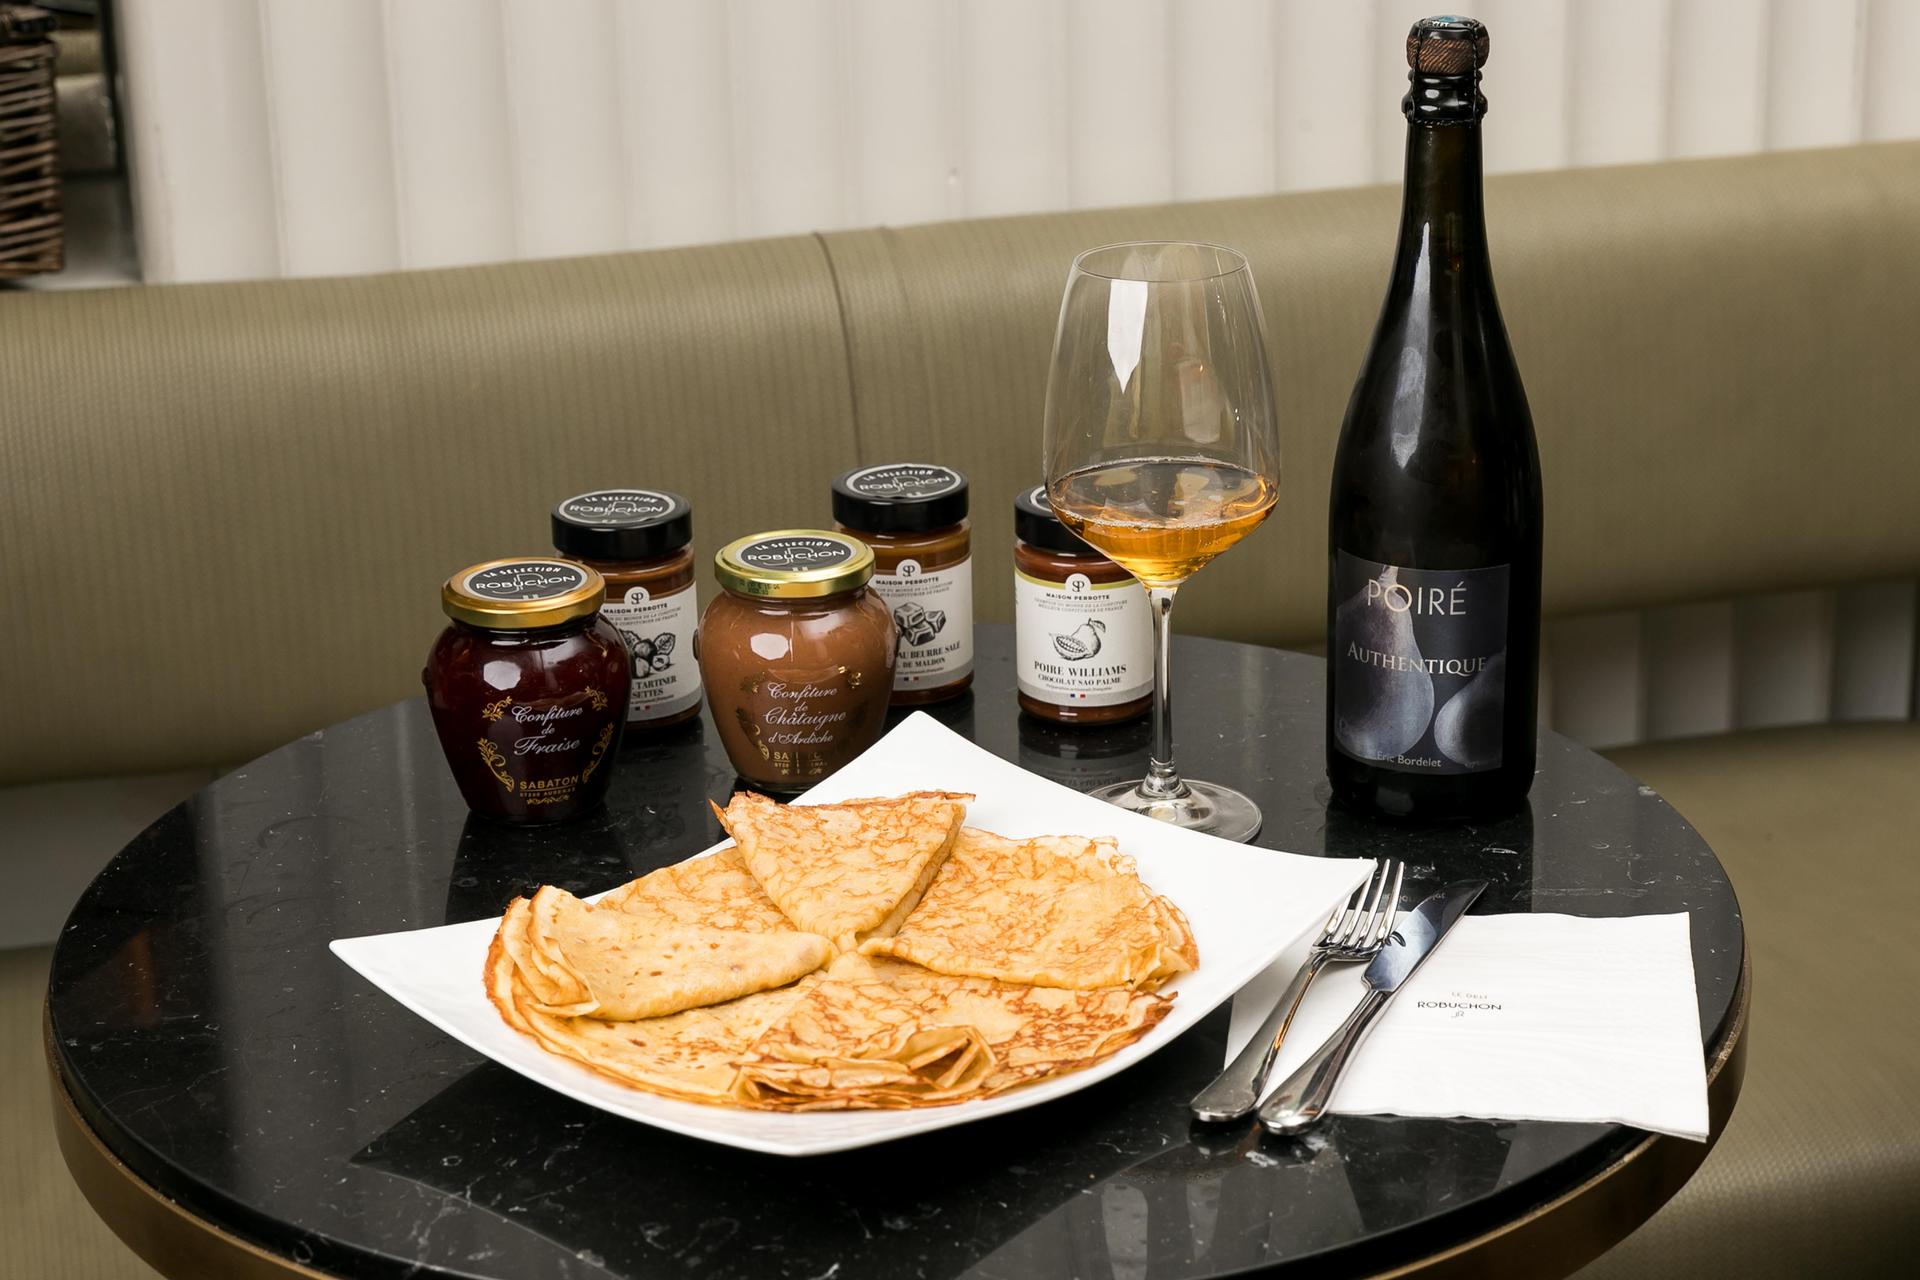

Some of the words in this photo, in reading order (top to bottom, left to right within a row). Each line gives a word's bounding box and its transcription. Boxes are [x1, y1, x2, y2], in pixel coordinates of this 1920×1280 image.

[860, 476, 950, 490] ROBUCHON
[569, 504, 664, 513] ROBUCHON
[747, 549, 845, 561] ROBUCHON
[500, 567, 562, 575] SELECTION
[476, 575, 576, 590] ROBUCHON
[905, 577, 939, 586] PERROTTE
[1367, 579, 1467, 616] POIRÉ
[633, 603, 668, 613] PERROTTE
[910, 646, 944, 659] BEURRE
[903, 660, 912, 668] DE
[915, 657, 946, 668] MALDON
[1347, 642, 1487, 677] AUTHENTIQUE
[1034, 660, 1064, 675] POIRE
[1068, 664, 1127, 677] WILLIAMS
[636, 675, 677, 690] TARTINER
[1038, 673, 1075, 686] CHOCOLAT
[1096, 676, 1121, 685] PALME
[631, 687, 664, 699] SETTES
[767, 682, 838, 703] Confiture
[794, 701, 808, 712] de
[511, 705, 583, 726] Confiture
[763, 706, 847, 731] Châtaigne
[541, 723, 555, 735] de
[513, 735, 581, 756] Fraise
[1398, 755, 1442, 768] Bordelet
[520, 775, 578, 790] SABATON
[1417, 1001, 1502, 1010] ROBUCHON
